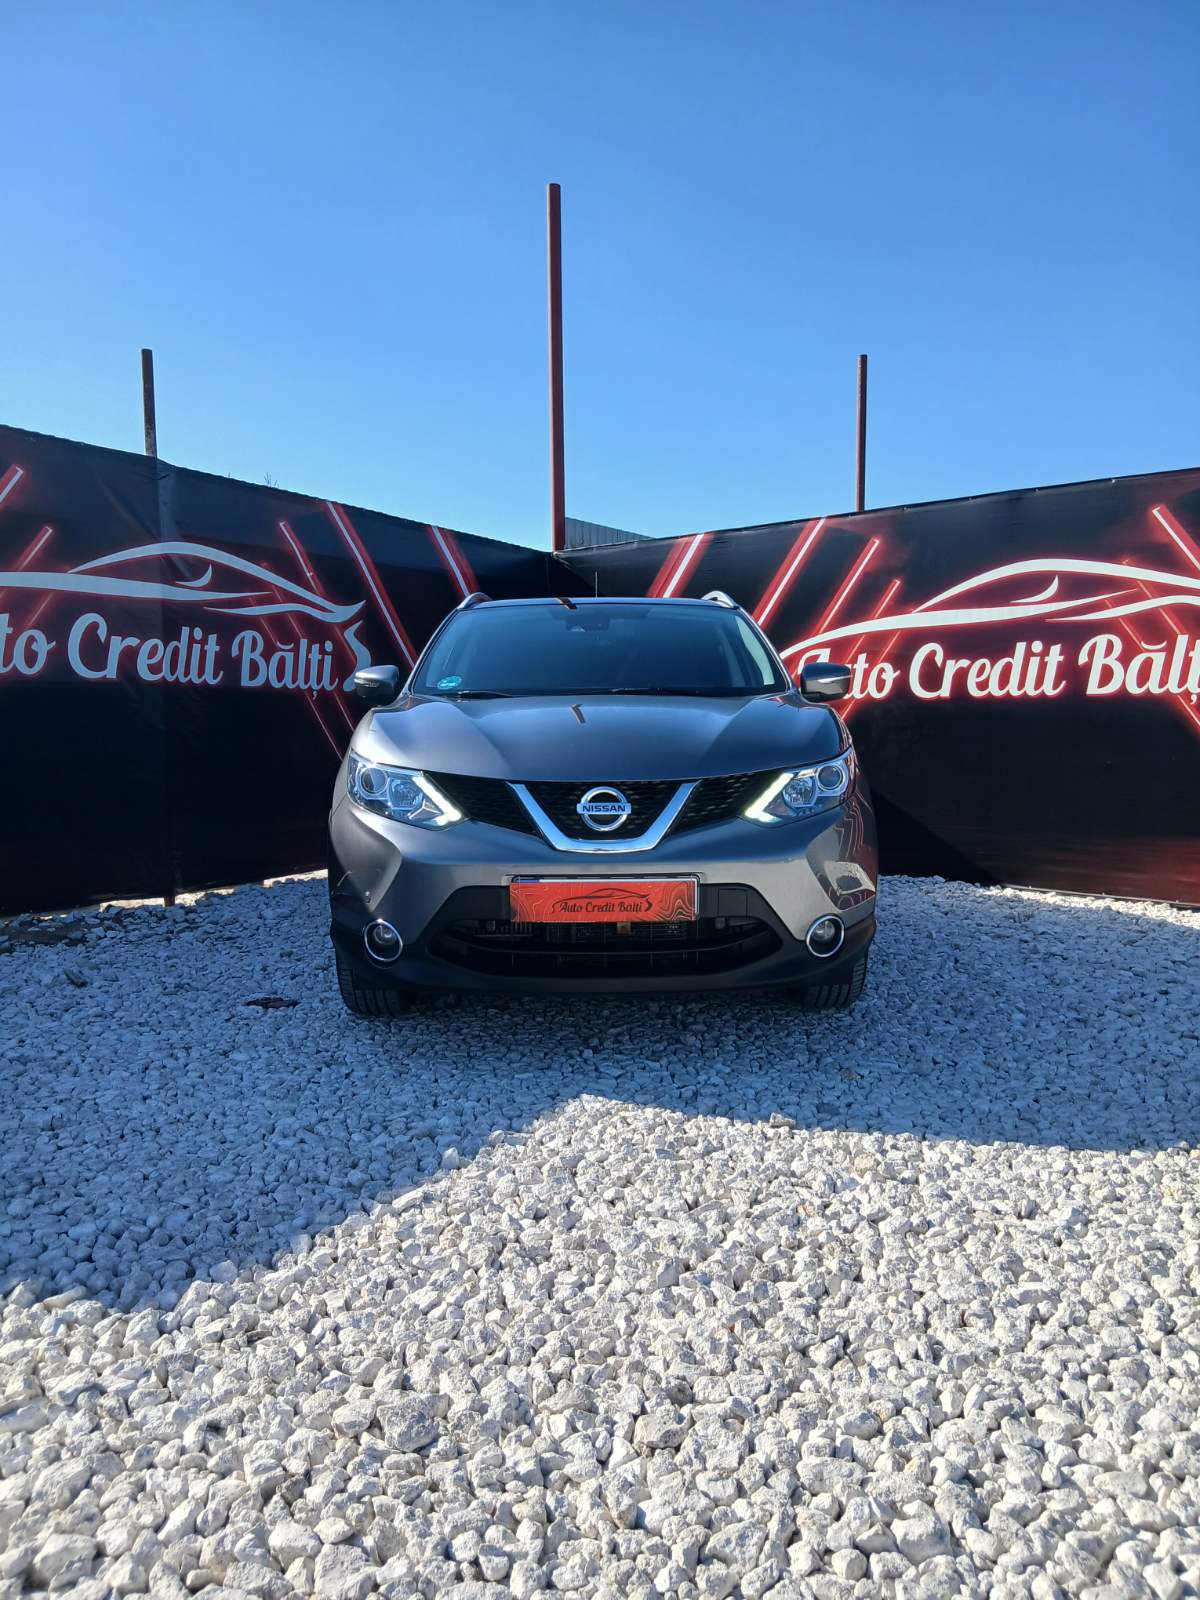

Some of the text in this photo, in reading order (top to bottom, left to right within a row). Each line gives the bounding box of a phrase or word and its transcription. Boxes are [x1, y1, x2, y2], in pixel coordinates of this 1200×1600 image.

[67, 612, 223, 686] Credit
[231, 629, 339, 700] Bălți
[797, 647, 900, 699] to
[908, 640, 1066, 698] Credit
[582, 804, 626, 813] NISSAN
[559, 901, 582, 912] Auto
[585, 901, 615, 912] Credit
